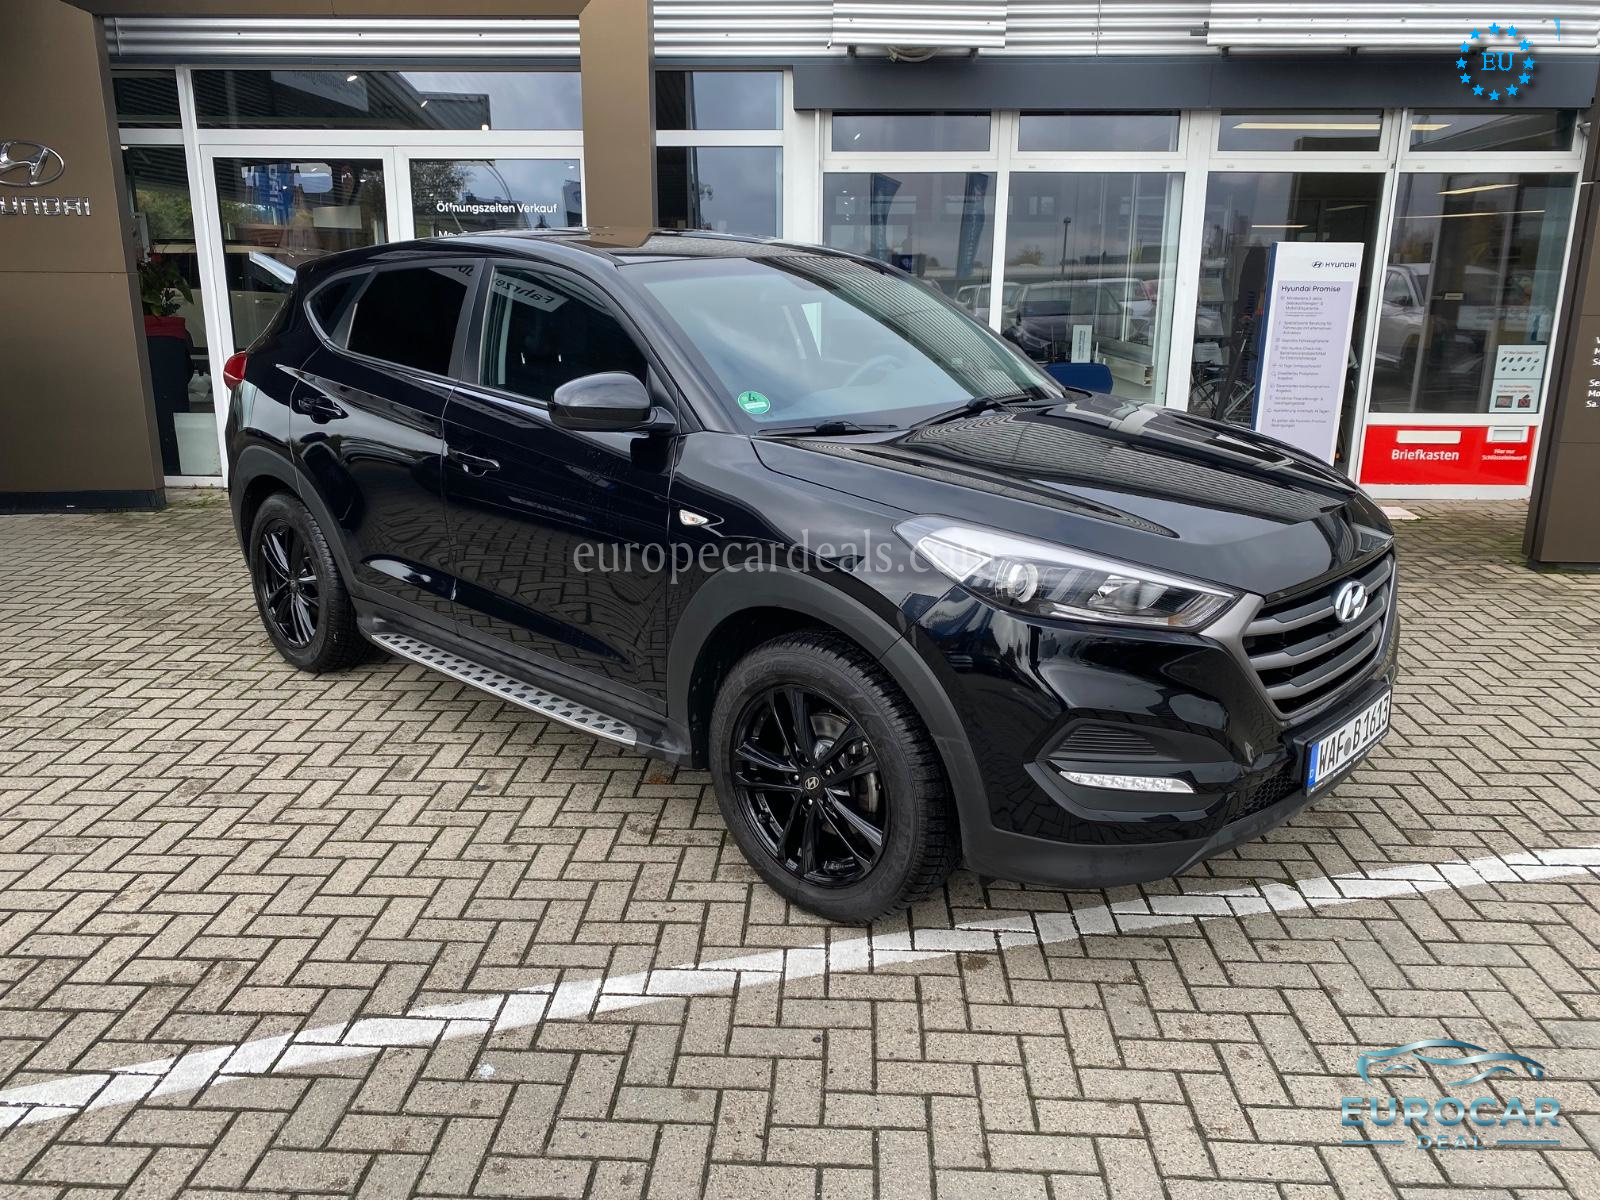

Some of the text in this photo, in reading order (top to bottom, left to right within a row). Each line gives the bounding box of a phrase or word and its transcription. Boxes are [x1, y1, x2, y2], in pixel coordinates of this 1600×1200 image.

[516, 203, 558, 213] Verkauf
[1281, 285, 1311, 293] Hyundai
[1391, 448, 1460, 461] Briefkasten
[1319, 729, 1346, 776] WAF
